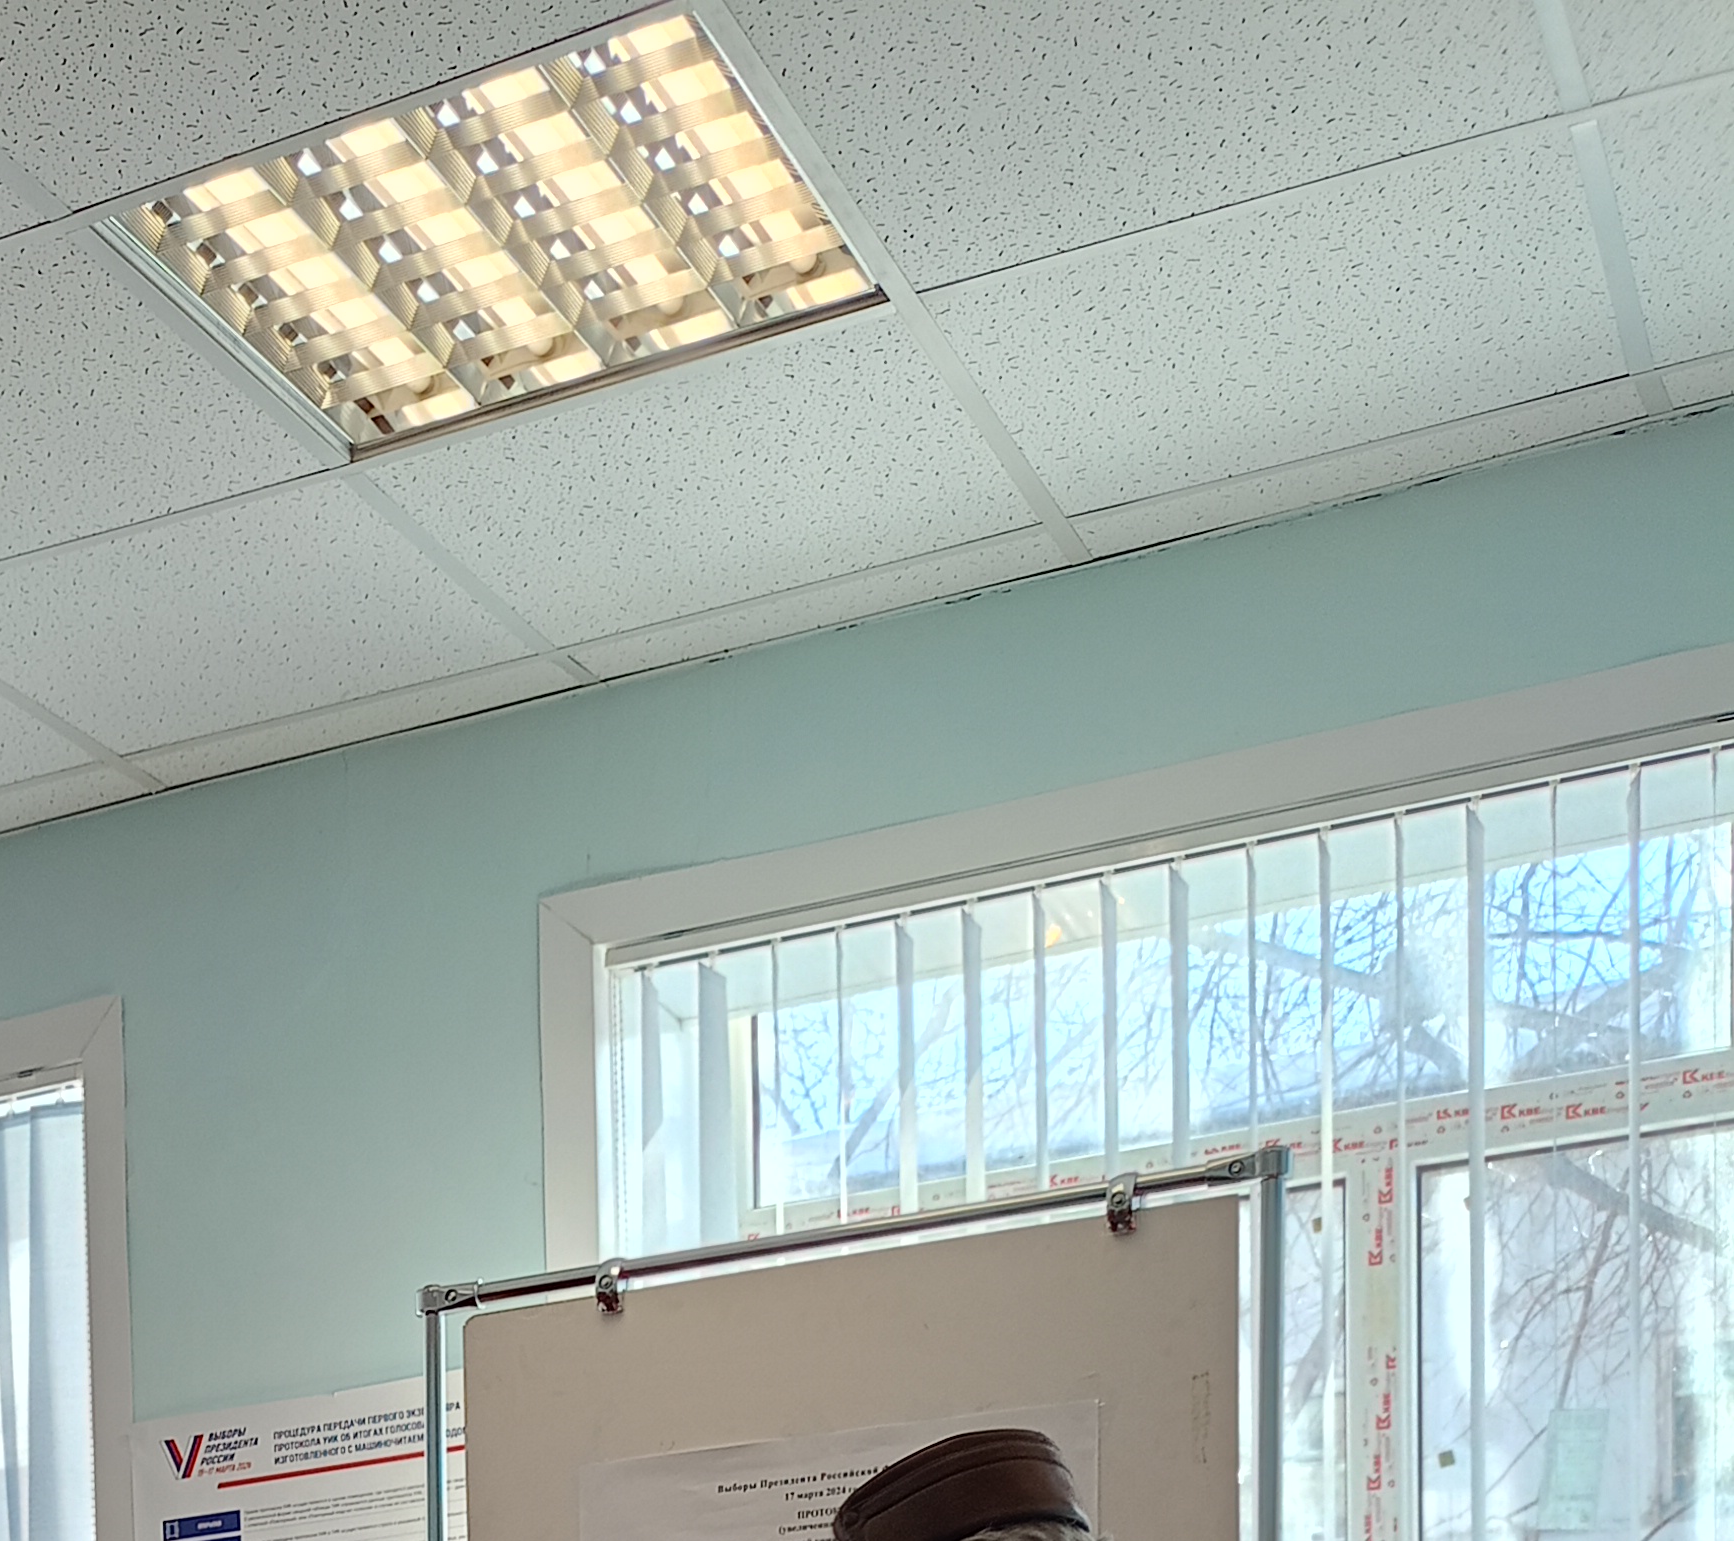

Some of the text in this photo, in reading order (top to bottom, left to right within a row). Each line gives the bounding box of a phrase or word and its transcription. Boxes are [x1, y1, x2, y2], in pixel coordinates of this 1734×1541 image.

[273, 1423, 321, 1441] ПРОЦЕДУРА
[322, 1416, 366, 1433] ПЕРЕДАЧИ
[367, 1410, 402, 1425] ПЕРВОГО
[208, 1427, 246, 1442] ВЫБОРЫ
[204, 1437, 259, 1454] ПРЕЗИДЕНТА
[273, 1436, 321, 1453] ПРОТОКОЛА
[200, 1453, 235, 1466] РОССИИ
[717, 1479, 757, 1495] Выборы
[759, 1472, 817, 1489] Президента
[820, 1467, 878, 1482] Российской
[796, 1490, 824, 1501] марта
[825, 1484, 846, 1497] 2024
